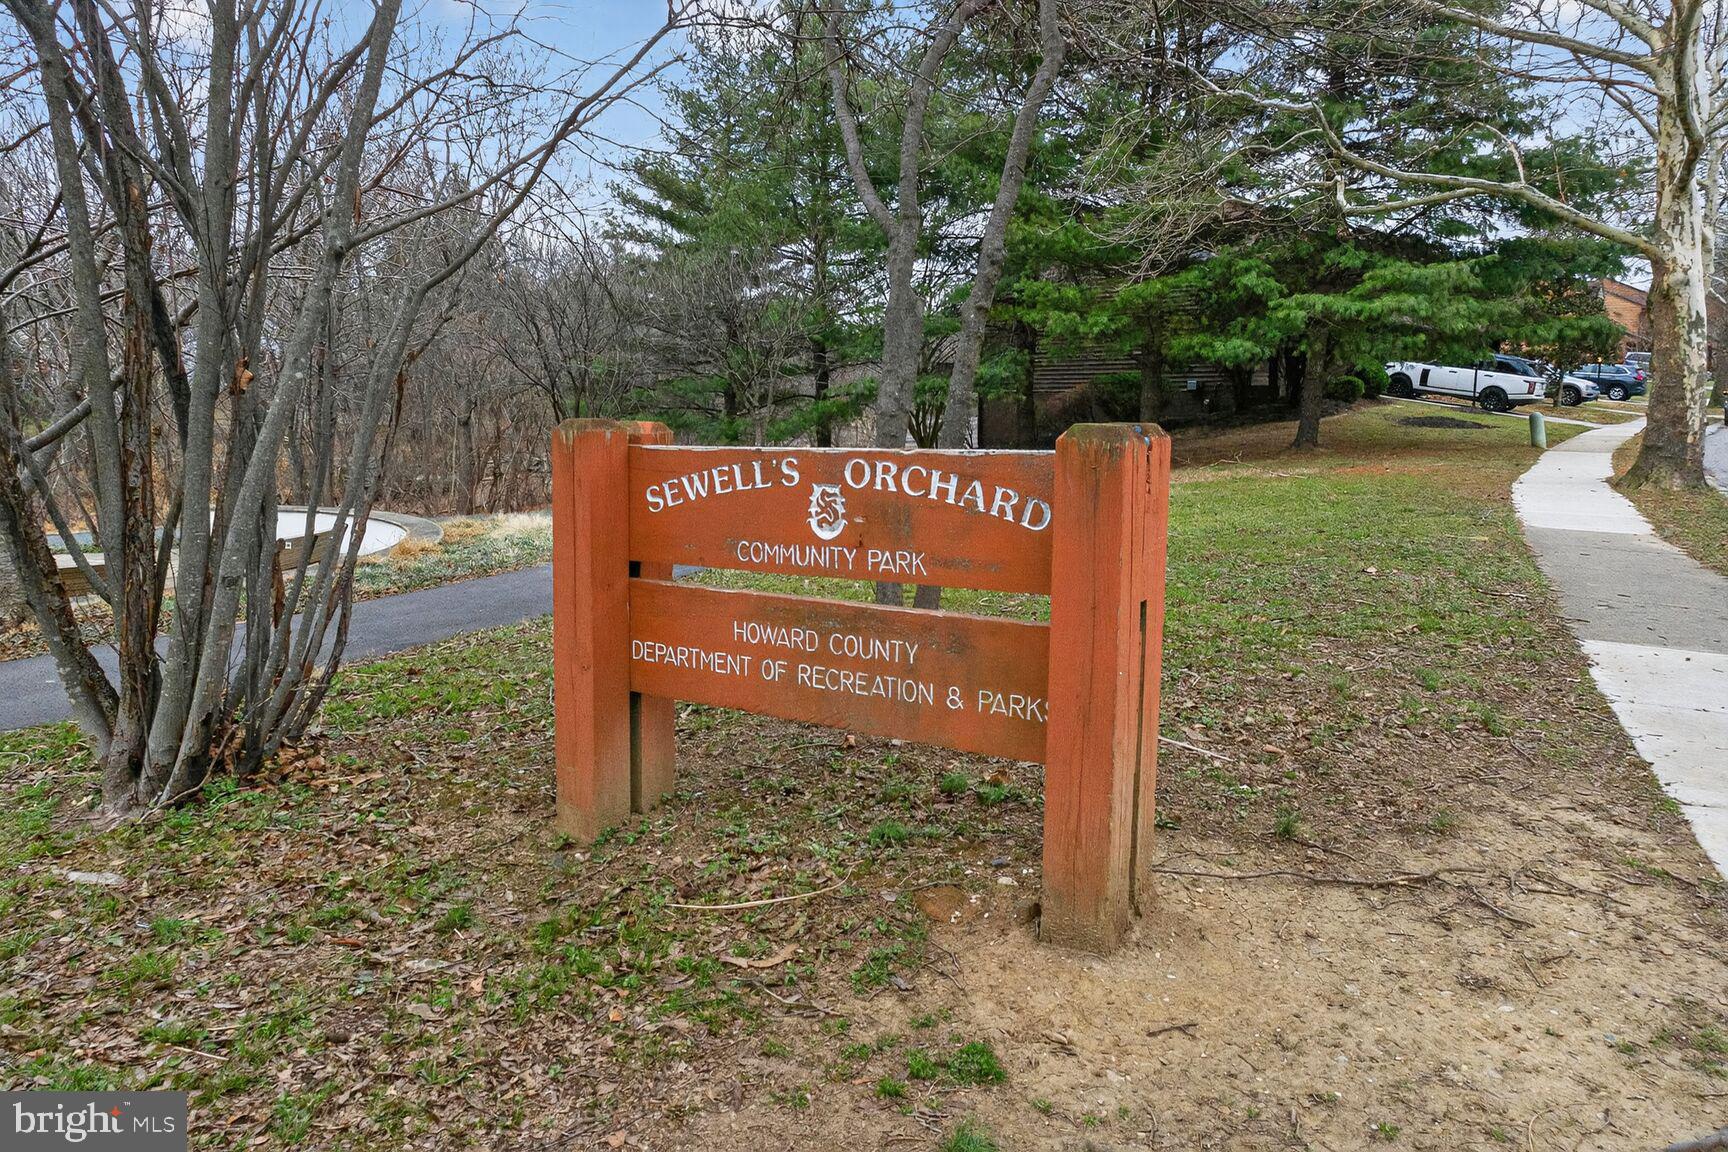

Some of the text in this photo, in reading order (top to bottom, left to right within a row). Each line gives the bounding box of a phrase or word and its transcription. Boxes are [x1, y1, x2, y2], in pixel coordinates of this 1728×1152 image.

[645, 457, 1053, 532] SEWELL'S ORCHARD
[736, 540, 928, 577] COMMUNITY PARK
[732, 619, 918, 664] HOWARD COUNTY
[631, 639, 1048, 722] DEPARTMENT OF RECREATION & PARK
